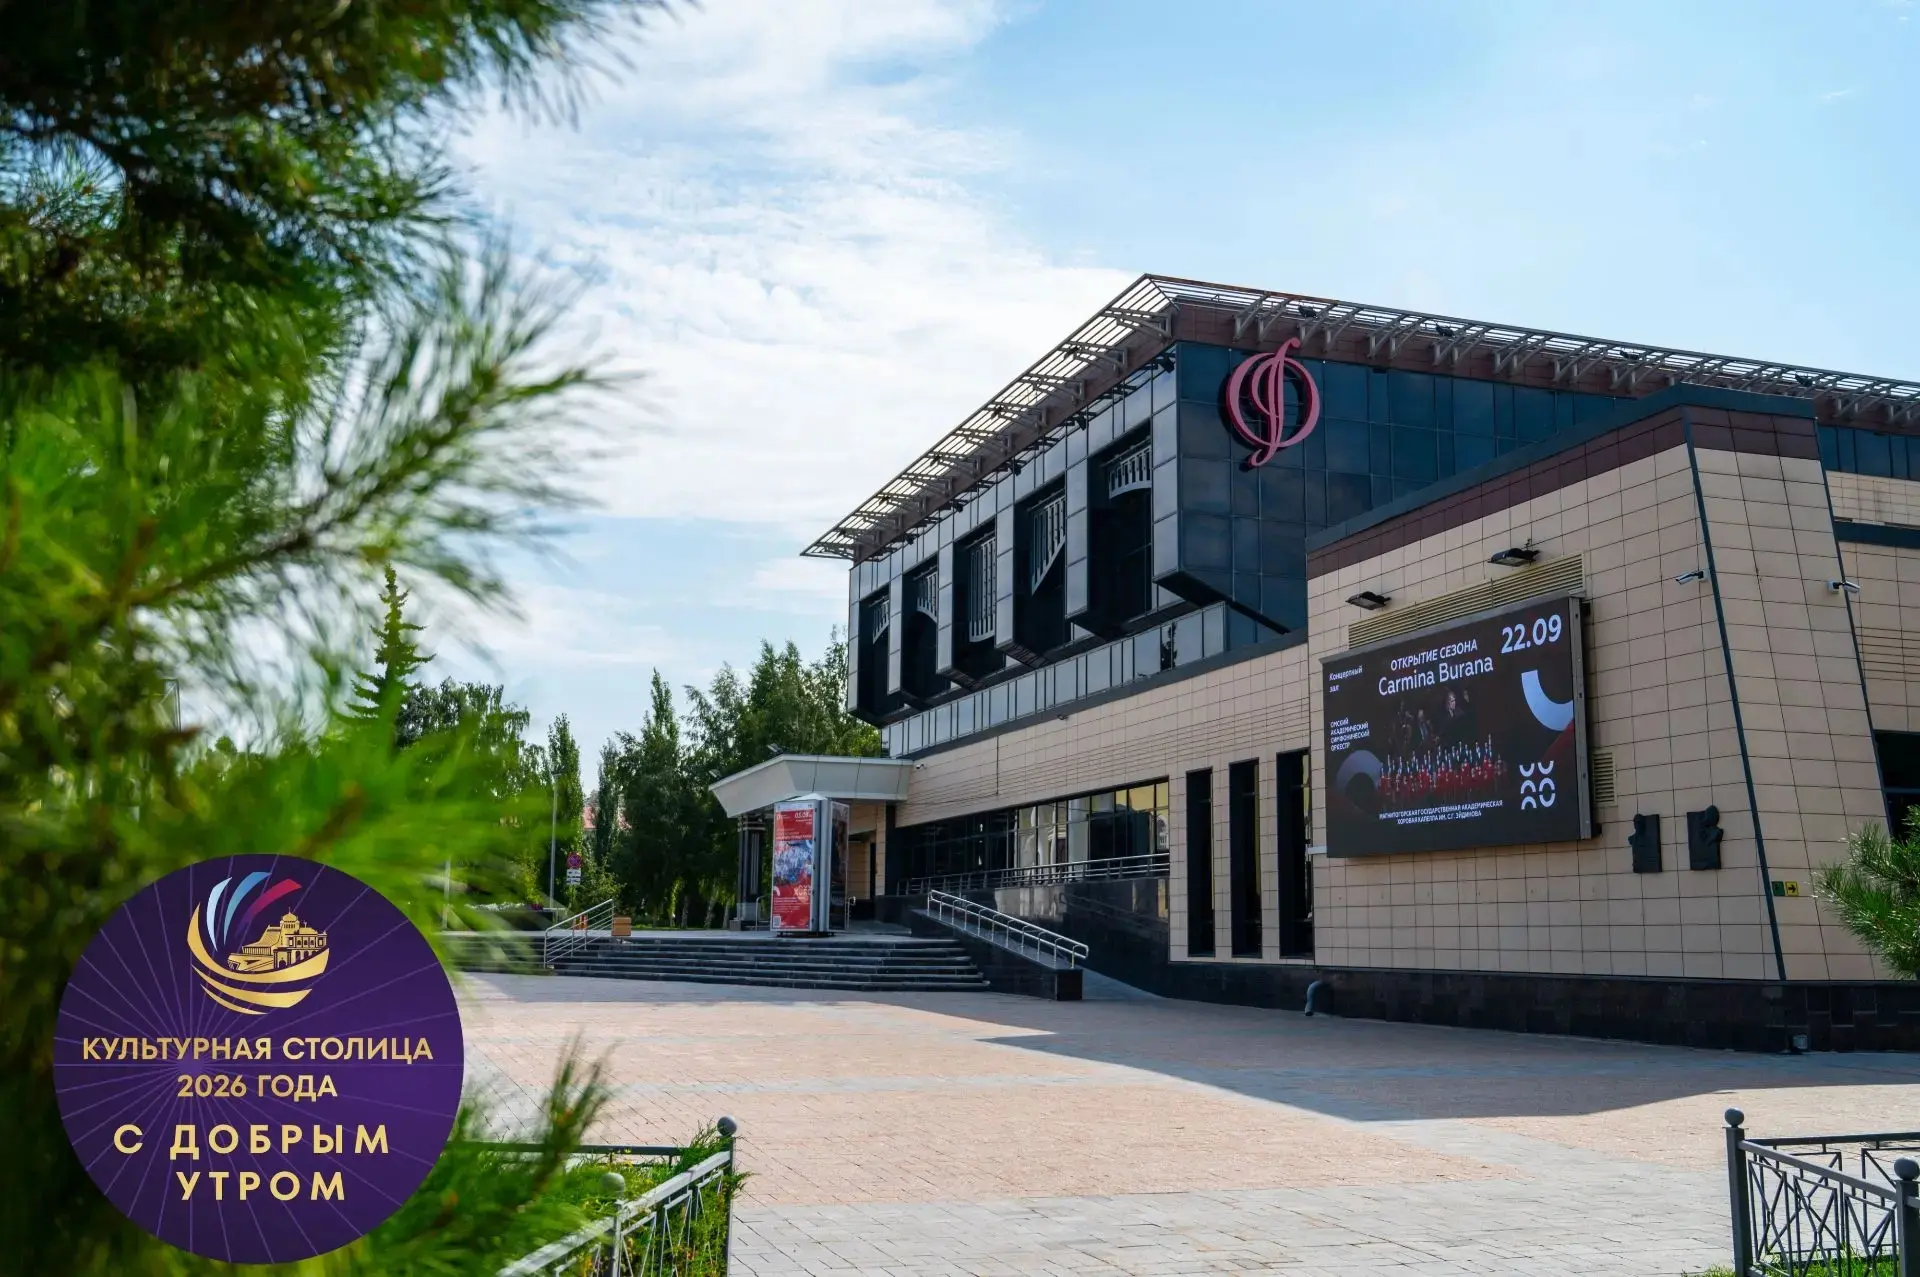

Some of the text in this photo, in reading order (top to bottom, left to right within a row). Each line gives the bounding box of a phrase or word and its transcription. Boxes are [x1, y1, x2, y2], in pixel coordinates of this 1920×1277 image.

[1501, 614, 1561, 653] 22.09
[1391, 639, 1478, 671] ОТКРЫТИЕ СЕЗОНА
[1329, 665, 1362, 680] Концертный
[1379, 657, 1493, 696] Carmina Burana
[1331, 721, 1368, 735] АКАДЕМИЧЕСКИЙ
[1331, 742, 1350, 751] ОРКЕСТР
[1417, 805, 1460, 815] ГОСУДАРСТВЕННАЯ
[1462, 800, 1503, 810] АКАДЕМИЧЕСКАЯ
